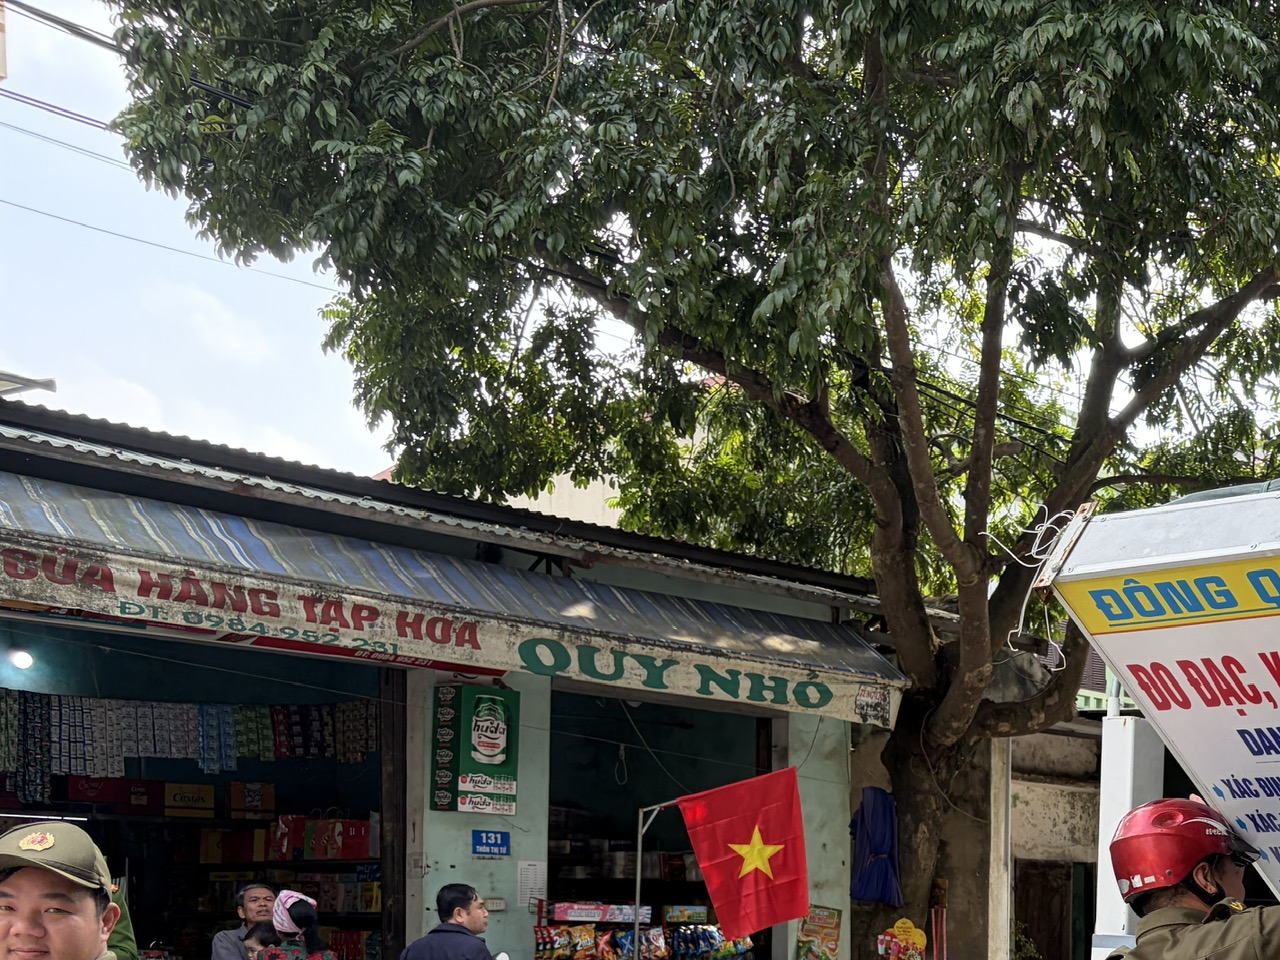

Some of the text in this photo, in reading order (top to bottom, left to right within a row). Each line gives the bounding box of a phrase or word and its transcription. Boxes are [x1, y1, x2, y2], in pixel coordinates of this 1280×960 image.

[137, 569, 281, 618] HÀNG
[298, 595, 380, 633] TẠP
[396, 610, 481, 650] HÓA
[1088, 576, 1239, 621] ĐÔNG
[518, 638, 679, 689] QUY
[1126, 661, 1192, 711] ĐO
[1175, 655, 1278, 716] ĐẠC,
[1220, 774, 1260, 799] XÁC
[481, 833, 502, 844] 131
